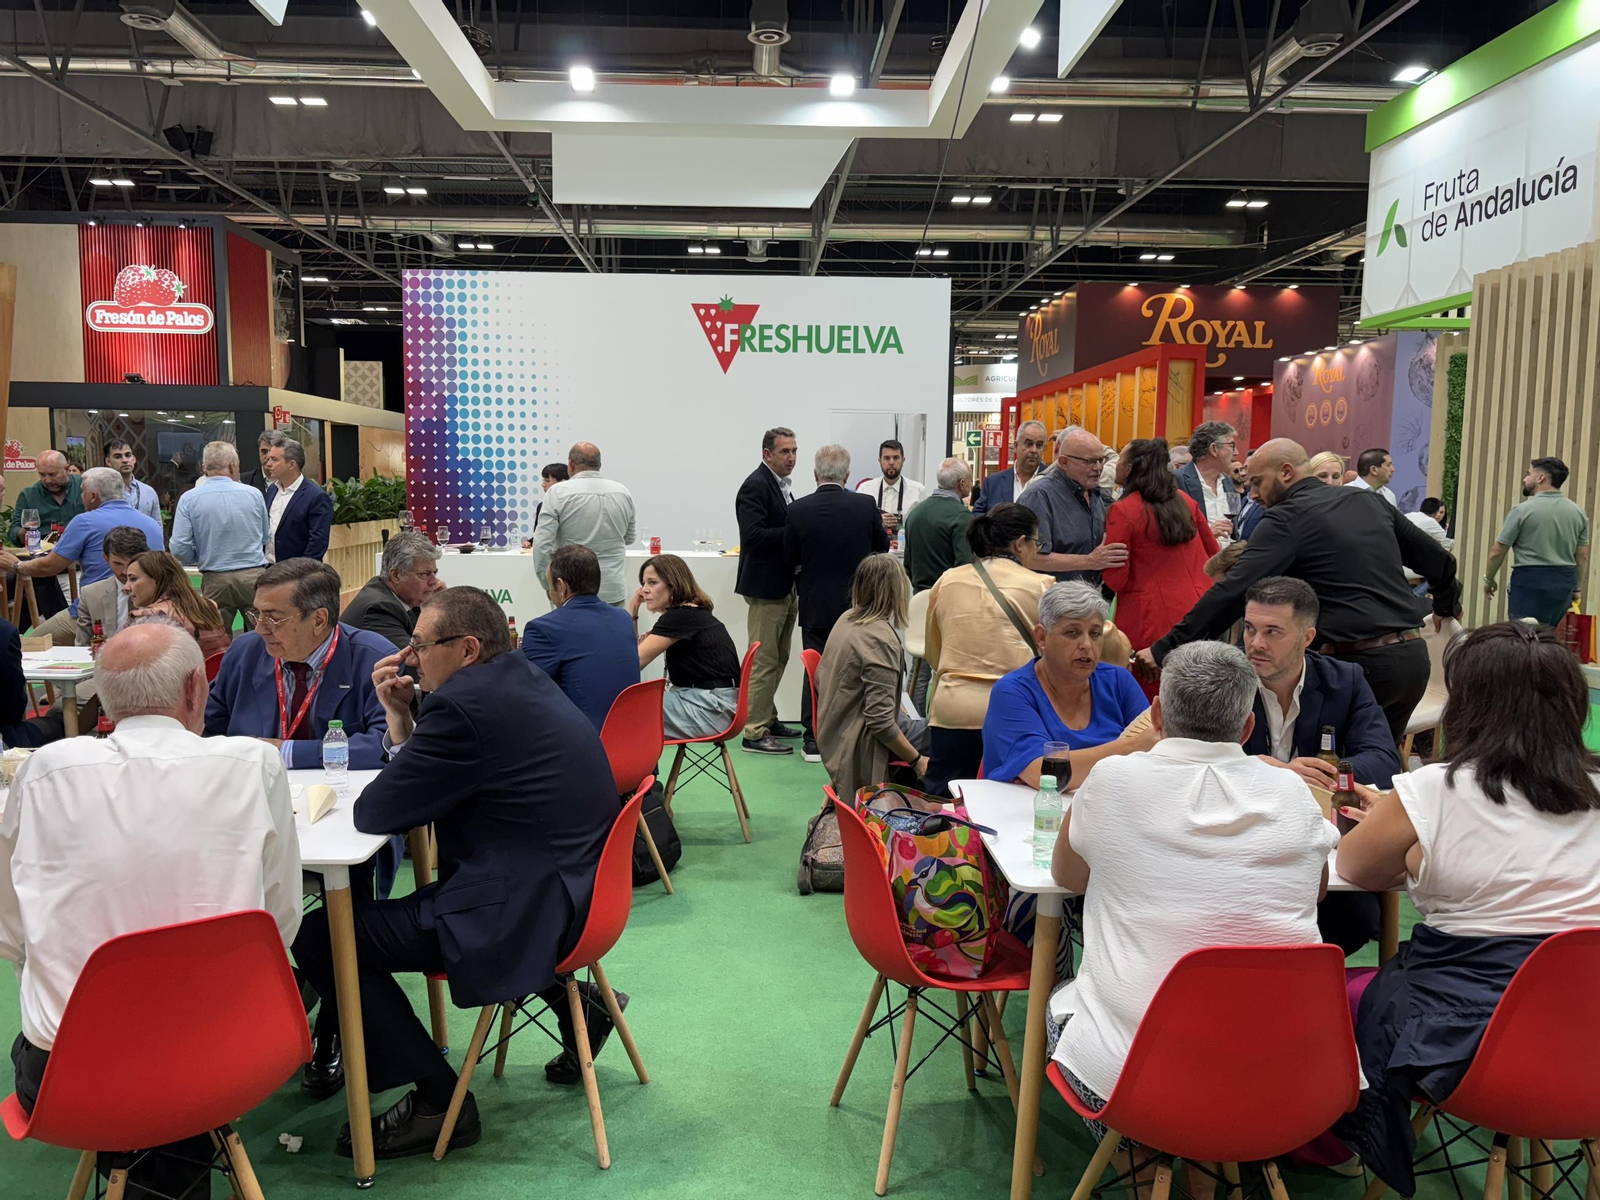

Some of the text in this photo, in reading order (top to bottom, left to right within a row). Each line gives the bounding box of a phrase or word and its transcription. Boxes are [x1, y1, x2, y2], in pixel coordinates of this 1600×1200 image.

[1421, 156, 1578, 242] de Andalucía
[1423, 168, 1480, 211] Fruta
[94, 309, 205, 327] Fresón de Palos
[724, 323, 904, 354] FRESHUELVA
[6, 460, 36, 469] de Palos
